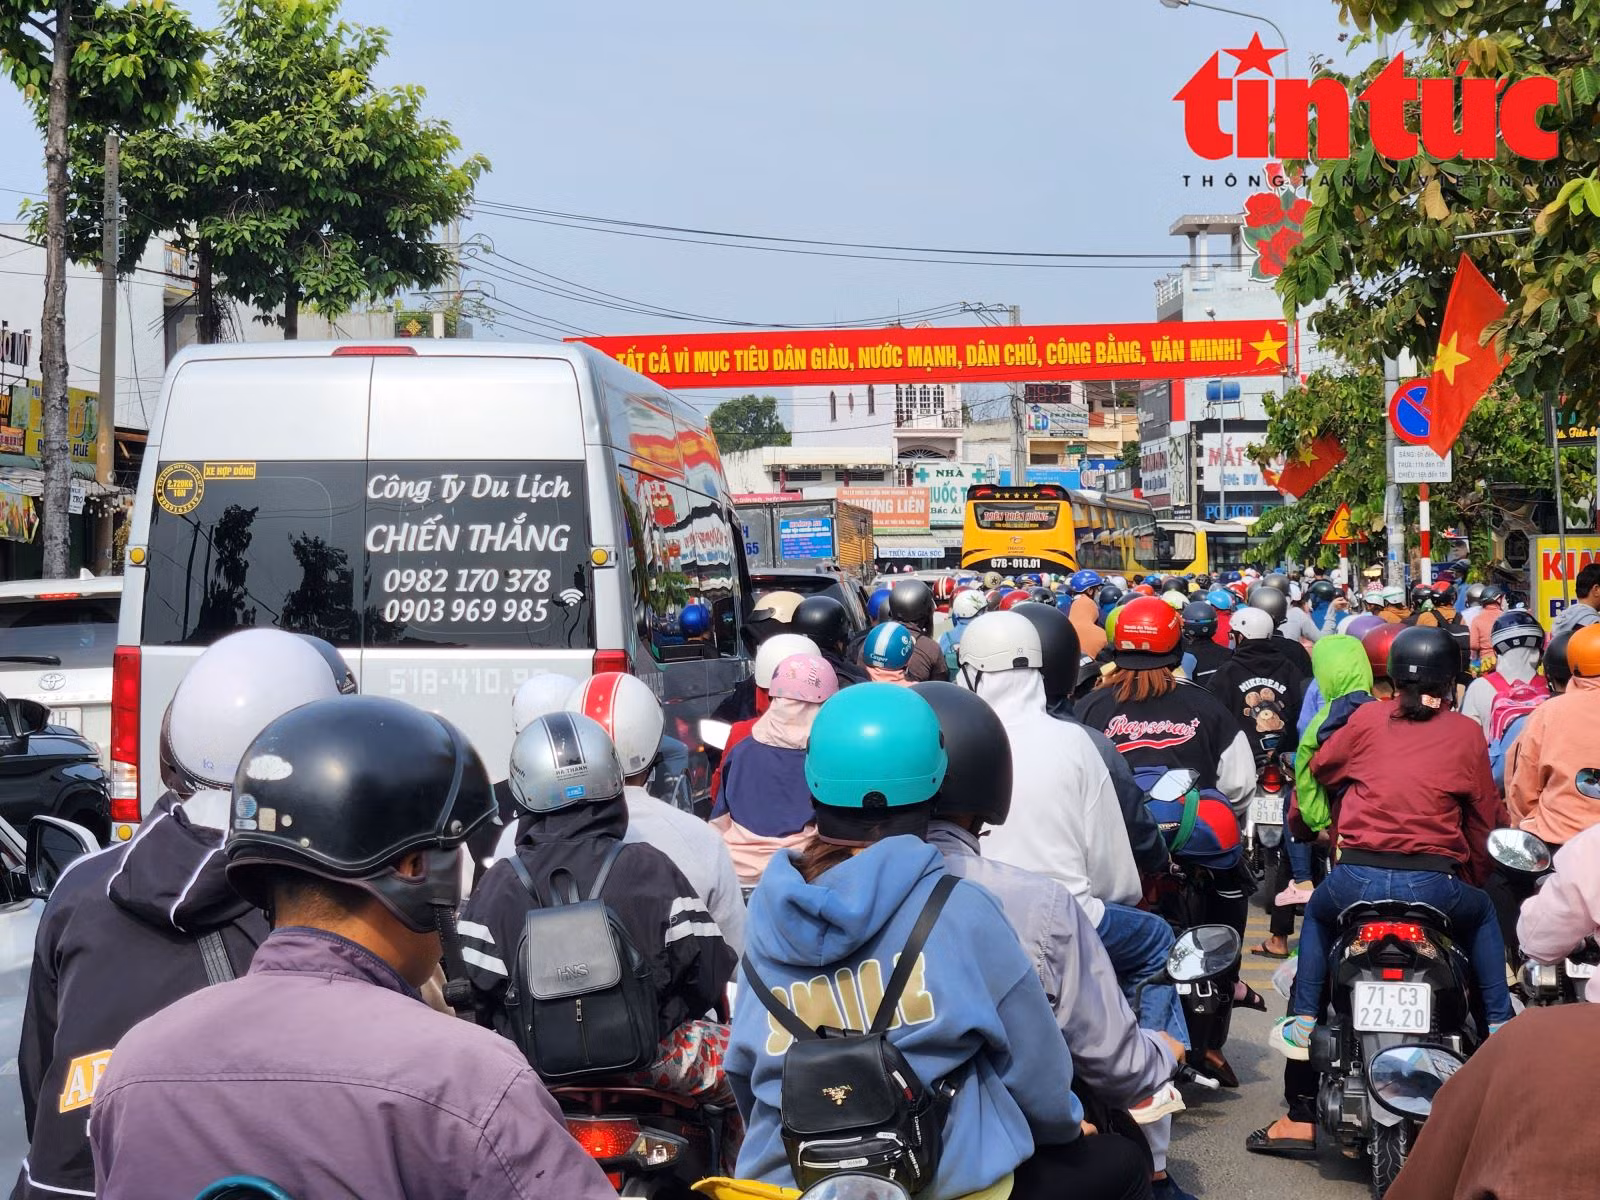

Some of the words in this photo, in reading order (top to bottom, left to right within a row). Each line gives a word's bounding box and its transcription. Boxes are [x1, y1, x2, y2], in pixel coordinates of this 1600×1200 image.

[616, 345, 645, 375] TẤT
[648, 345, 671, 374] CẢ
[674, 347, 690, 374] VÌ
[694, 350, 730, 377] MỤC
[734, 345, 769, 372] TIÊU
[773, 344, 807, 372] DÂN
[811, 343, 854, 371] GIÀU,
[858, 342, 903, 369] NƯỚC
[907, 345, 963, 372] MẠNH,
[966, 340, 1000, 367] DÂN
[1004, 336, 1043, 368] CHỦ,
[1046, 337, 1092, 365] CÔNG
[1095, 333, 1147, 366] BẰNG,
[1151, 335, 1185, 363] VĂN
[1190, 338, 1243, 362] MINH!
[205, 467, 216, 476] XE
[935, 467, 964, 477] NHÀ
[367, 474, 432, 504] Công
[441, 473, 465, 504] Ty
[471, 473, 509, 499] Du
[516, 473, 571, 504] Lịch
[930, 481, 957, 503] UỐC
[1205, 505, 1253, 520] POLICE
[366, 514, 460, 554] CHIẾN
[468, 512, 571, 554] THẮNG
[383, 569, 449, 593] 0982
[454, 569, 500, 593] 170
[503, 569, 551, 593] 378
[384, 598, 446, 623] 0903
[450, 598, 497, 623] 969
[502, 598, 549, 623] 985
[1238, 677, 1287, 695] MIKEBEAR
[1367, 986, 1418, 1006] 71-C3
[1360, 1008, 1424, 1028] 224.20
